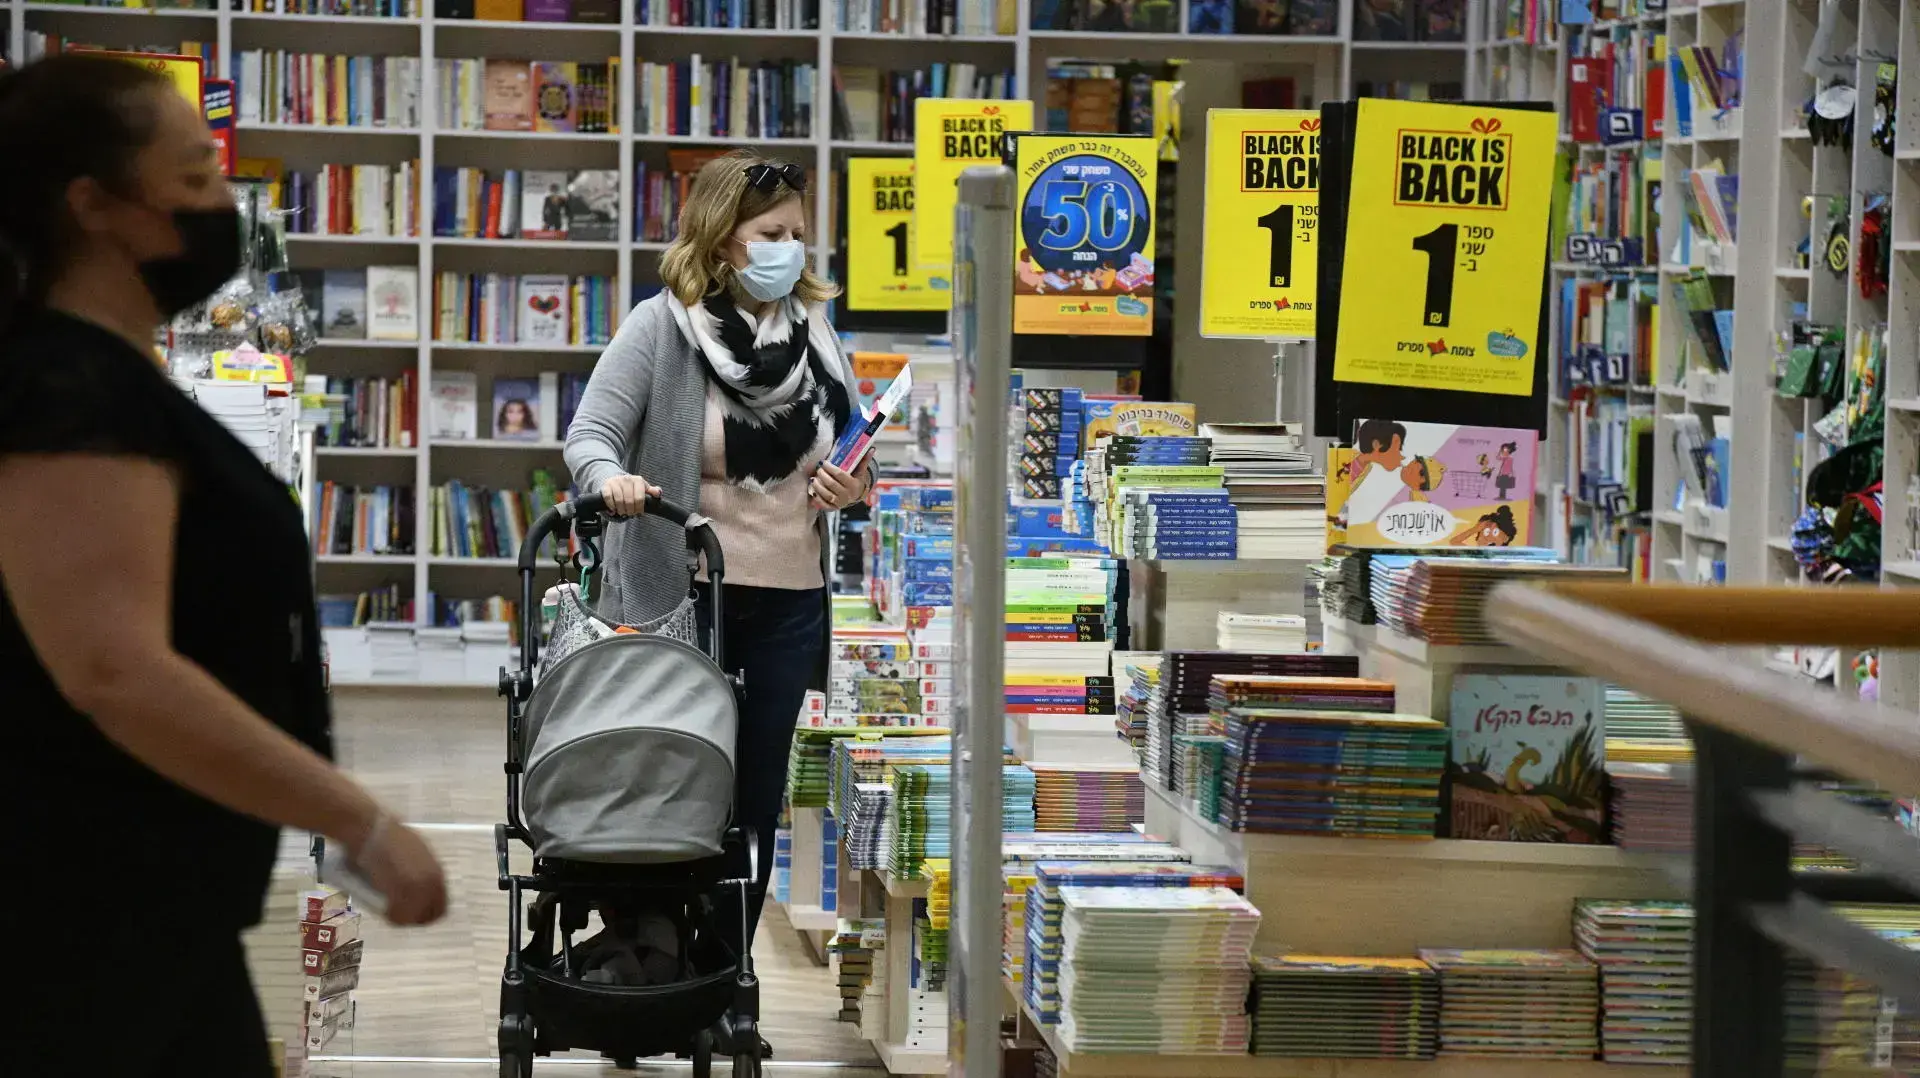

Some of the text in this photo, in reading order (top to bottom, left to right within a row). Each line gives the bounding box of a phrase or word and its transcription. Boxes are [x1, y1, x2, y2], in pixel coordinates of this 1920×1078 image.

[943, 118, 1003, 133] BLACK IS
[944, 135, 1002, 158] BACK
[1047, 143, 1076, 162] משחק
[1079, 142, 1098, 151] כבר
[1245, 135, 1304, 155] BLACK
[1401, 135, 1504, 163] BLACK IS
[1062, 166, 1111, 177] משחק שני
[1399, 162, 1505, 206] BACK
[1038, 180, 1135, 251] 50 %
[1296, 218, 1316, 229] שני
[1296, 232, 1310, 242] ב-
[1463, 225, 1494, 240] ספר
[885, 222, 908, 276] 1
[1258, 204, 1294, 287] 1
[1461, 241, 1485, 256] שני
[1072, 252, 1098, 261] הנחה
[1460, 258, 1477, 272] ב-
[1412, 223, 1458, 328] 1
[1250, 300, 1313, 310] צומת ספרים
[1397, 341, 1424, 353] ספרים
[1450, 345, 1476, 357] צומת
[1117, 408, 1154, 422] בריבוע
[1156, 409, 1193, 430] שוקולד
